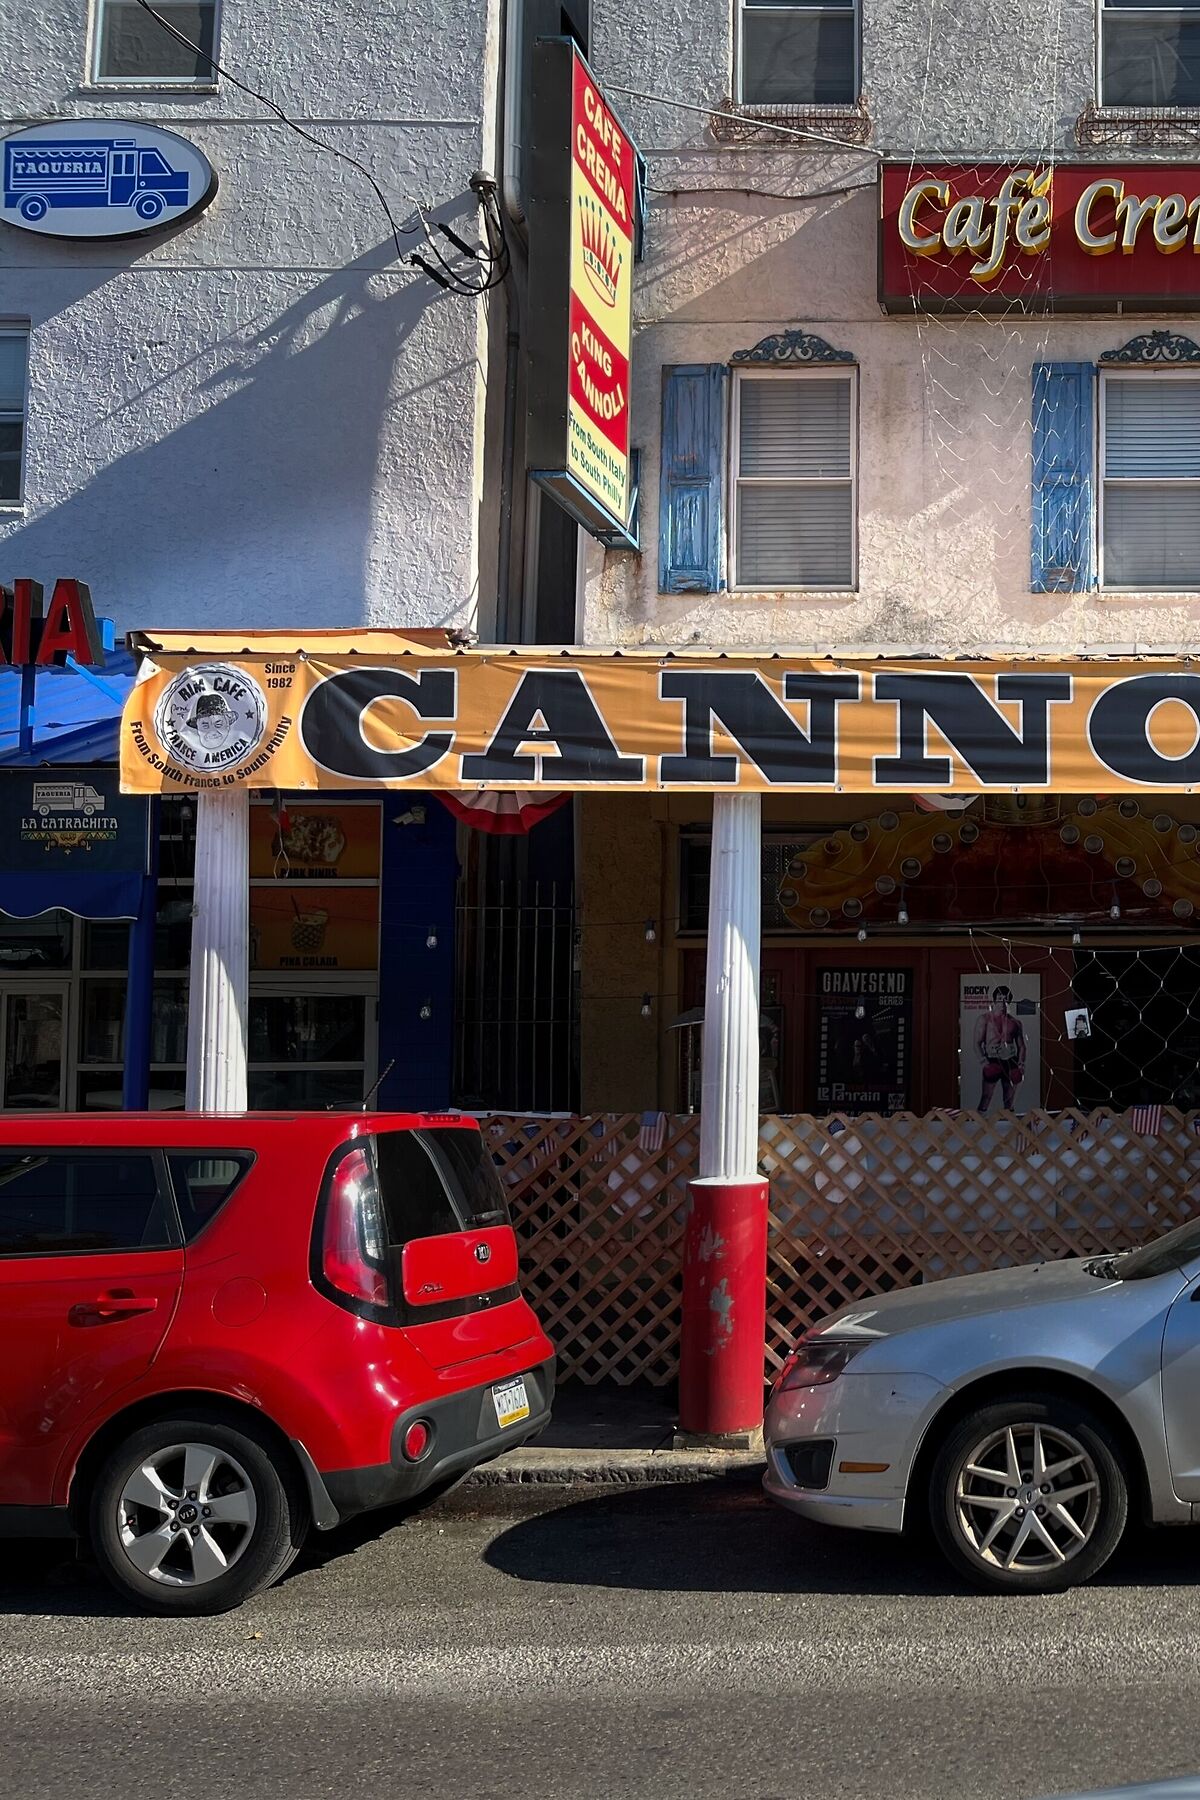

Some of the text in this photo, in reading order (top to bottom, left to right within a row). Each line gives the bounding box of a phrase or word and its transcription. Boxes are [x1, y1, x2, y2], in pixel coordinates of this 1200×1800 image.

[584, 86, 622, 167] CAFE
[15, 162, 103, 174] TAQUERIA
[576, 123, 627, 222] CREMA
[898, 168, 1053, 281] Café
[581, 321, 612, 378] KING
[572, 331, 625, 420] CANNOLI
[569, 409, 626, 487] From South Italy
[571, 441, 622, 509] to South Philly
[264, 663, 296, 674] Since
[266, 677, 293, 688] 1982
[178, 677, 247, 701] RIM CAFE
[130, 715, 293, 789] From South France to South Philly
[166, 730, 249, 764] FRANCE AMERICA
[21, 817, 119, 829] LA CATRACHITA
[822, 972, 906, 993] GRAVESEND
[964, 986, 990, 995] ROCKY
[879, 996, 904, 1006] SERIES
